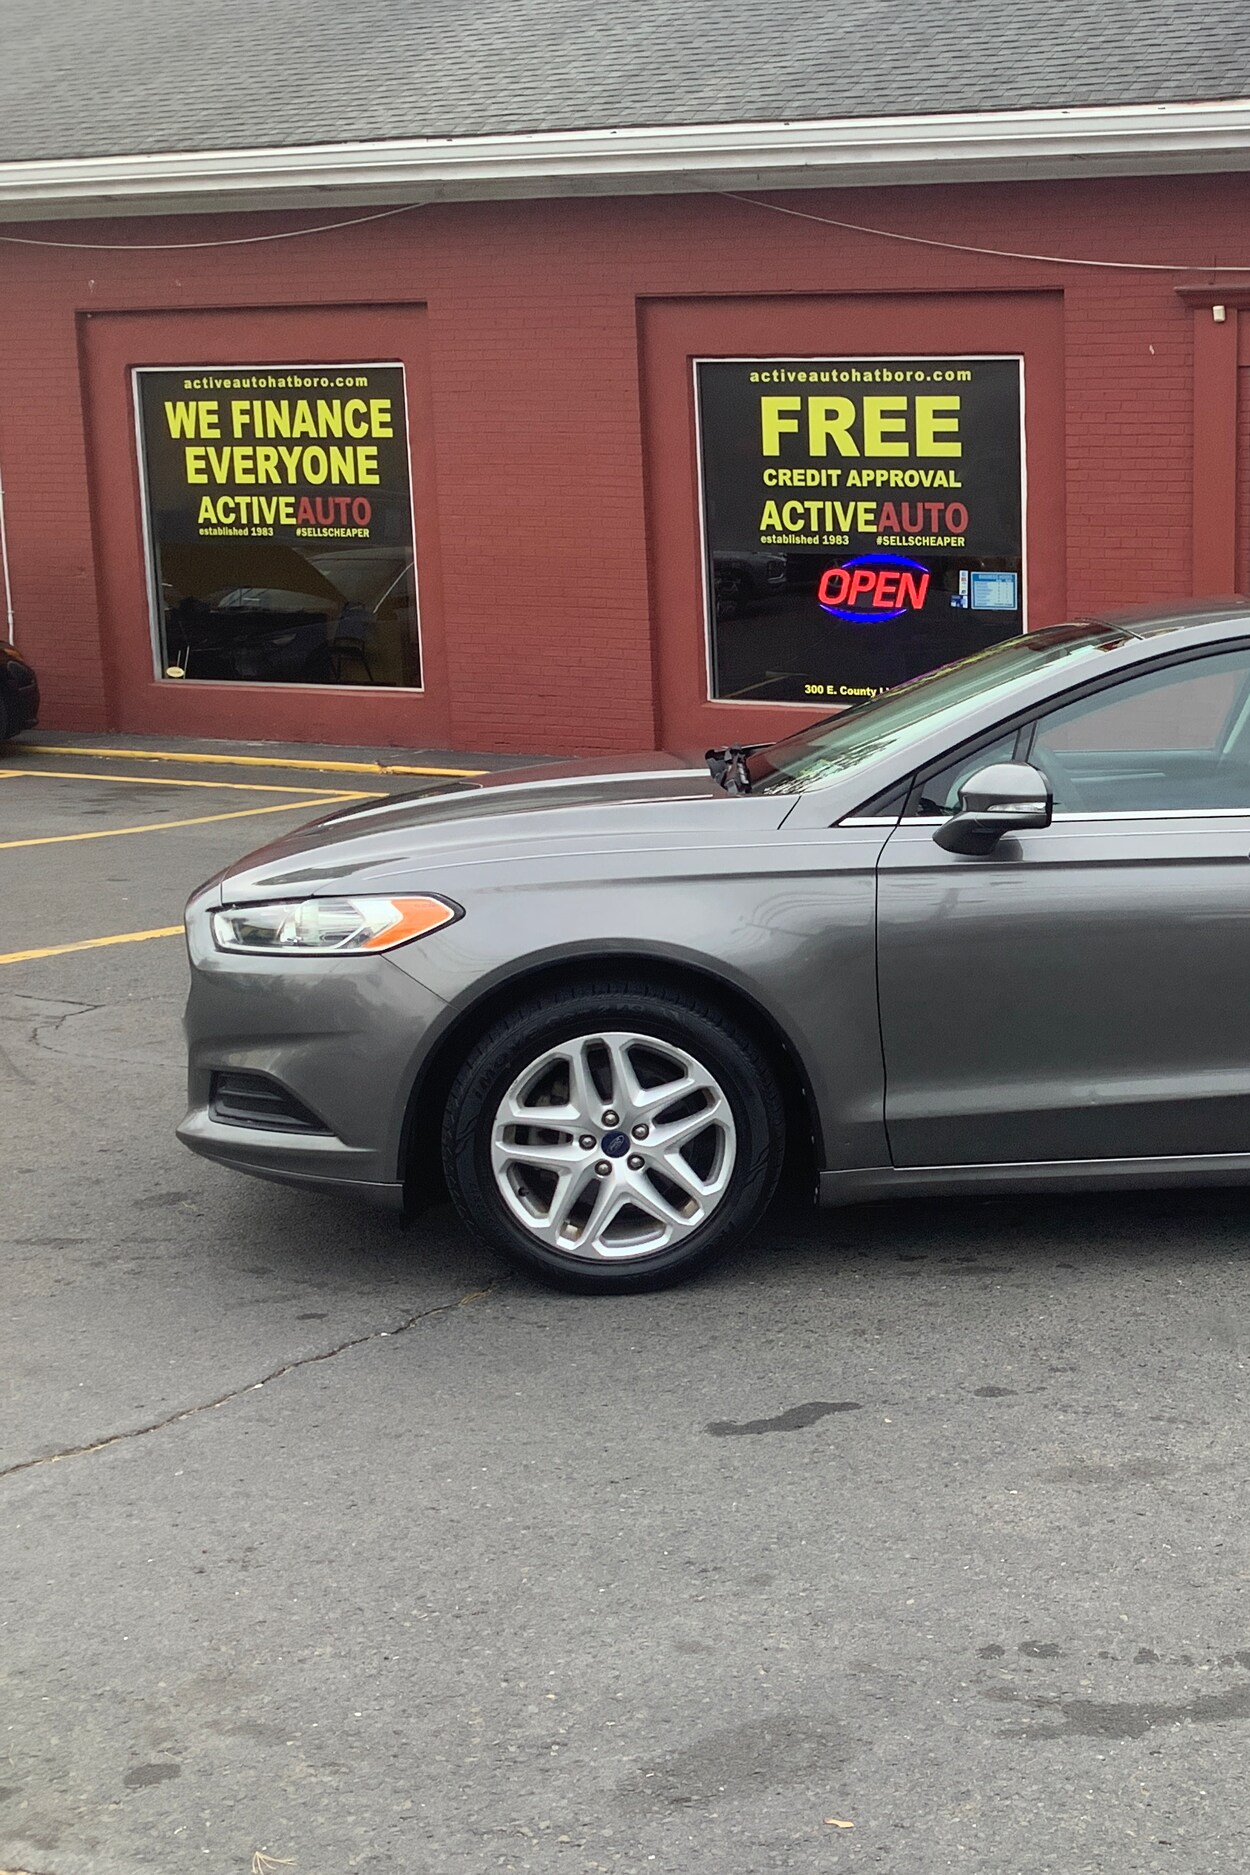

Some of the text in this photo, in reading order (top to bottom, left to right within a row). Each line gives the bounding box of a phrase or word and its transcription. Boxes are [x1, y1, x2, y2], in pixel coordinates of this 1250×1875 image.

[183, 375, 369, 389] activeautohatboro.com
[750, 368, 972, 382] activeautohatboro.com
[164, 399, 394, 439] WE FINANCE
[760, 396, 962, 457] FREE
[185, 446, 380, 485] EVERYONE
[763, 469, 962, 488] CREDIT APPROVAL
[199, 527, 370, 538] established 1983 #SELLSCHEAPER
[760, 534, 965, 547] established 1983 #SELLSCHEAPER
[818, 569, 930, 610] OPEN
[804, 685, 824, 694] 300
[826, 685, 837, 695] E.
[840, 686, 876, 698] County
